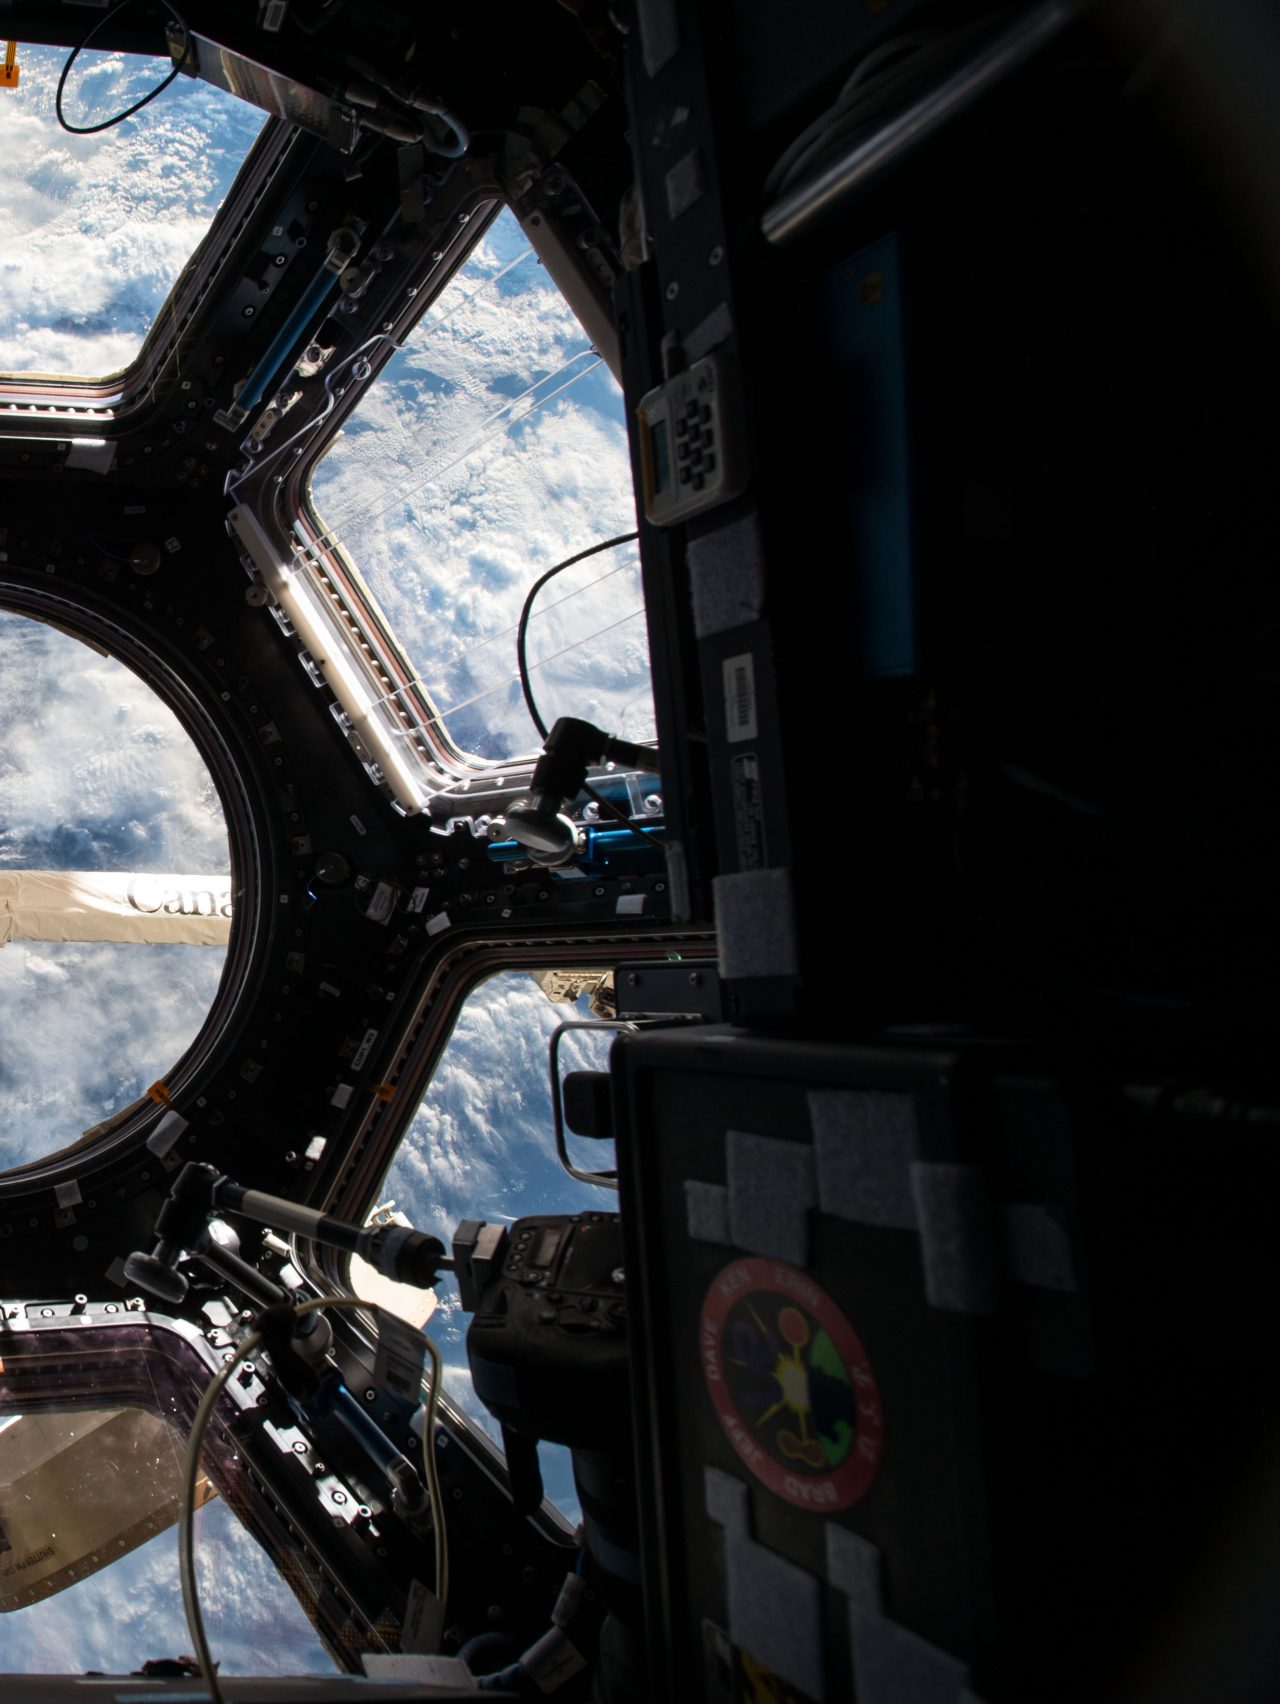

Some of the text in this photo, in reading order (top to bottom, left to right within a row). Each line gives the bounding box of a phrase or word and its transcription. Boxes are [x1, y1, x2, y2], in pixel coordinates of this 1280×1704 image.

[704, 1318, 720, 1380] DAVE
[783, 1476, 839, 1504] BRAD
[27, 1546, 55, 1566] SHUTTER
